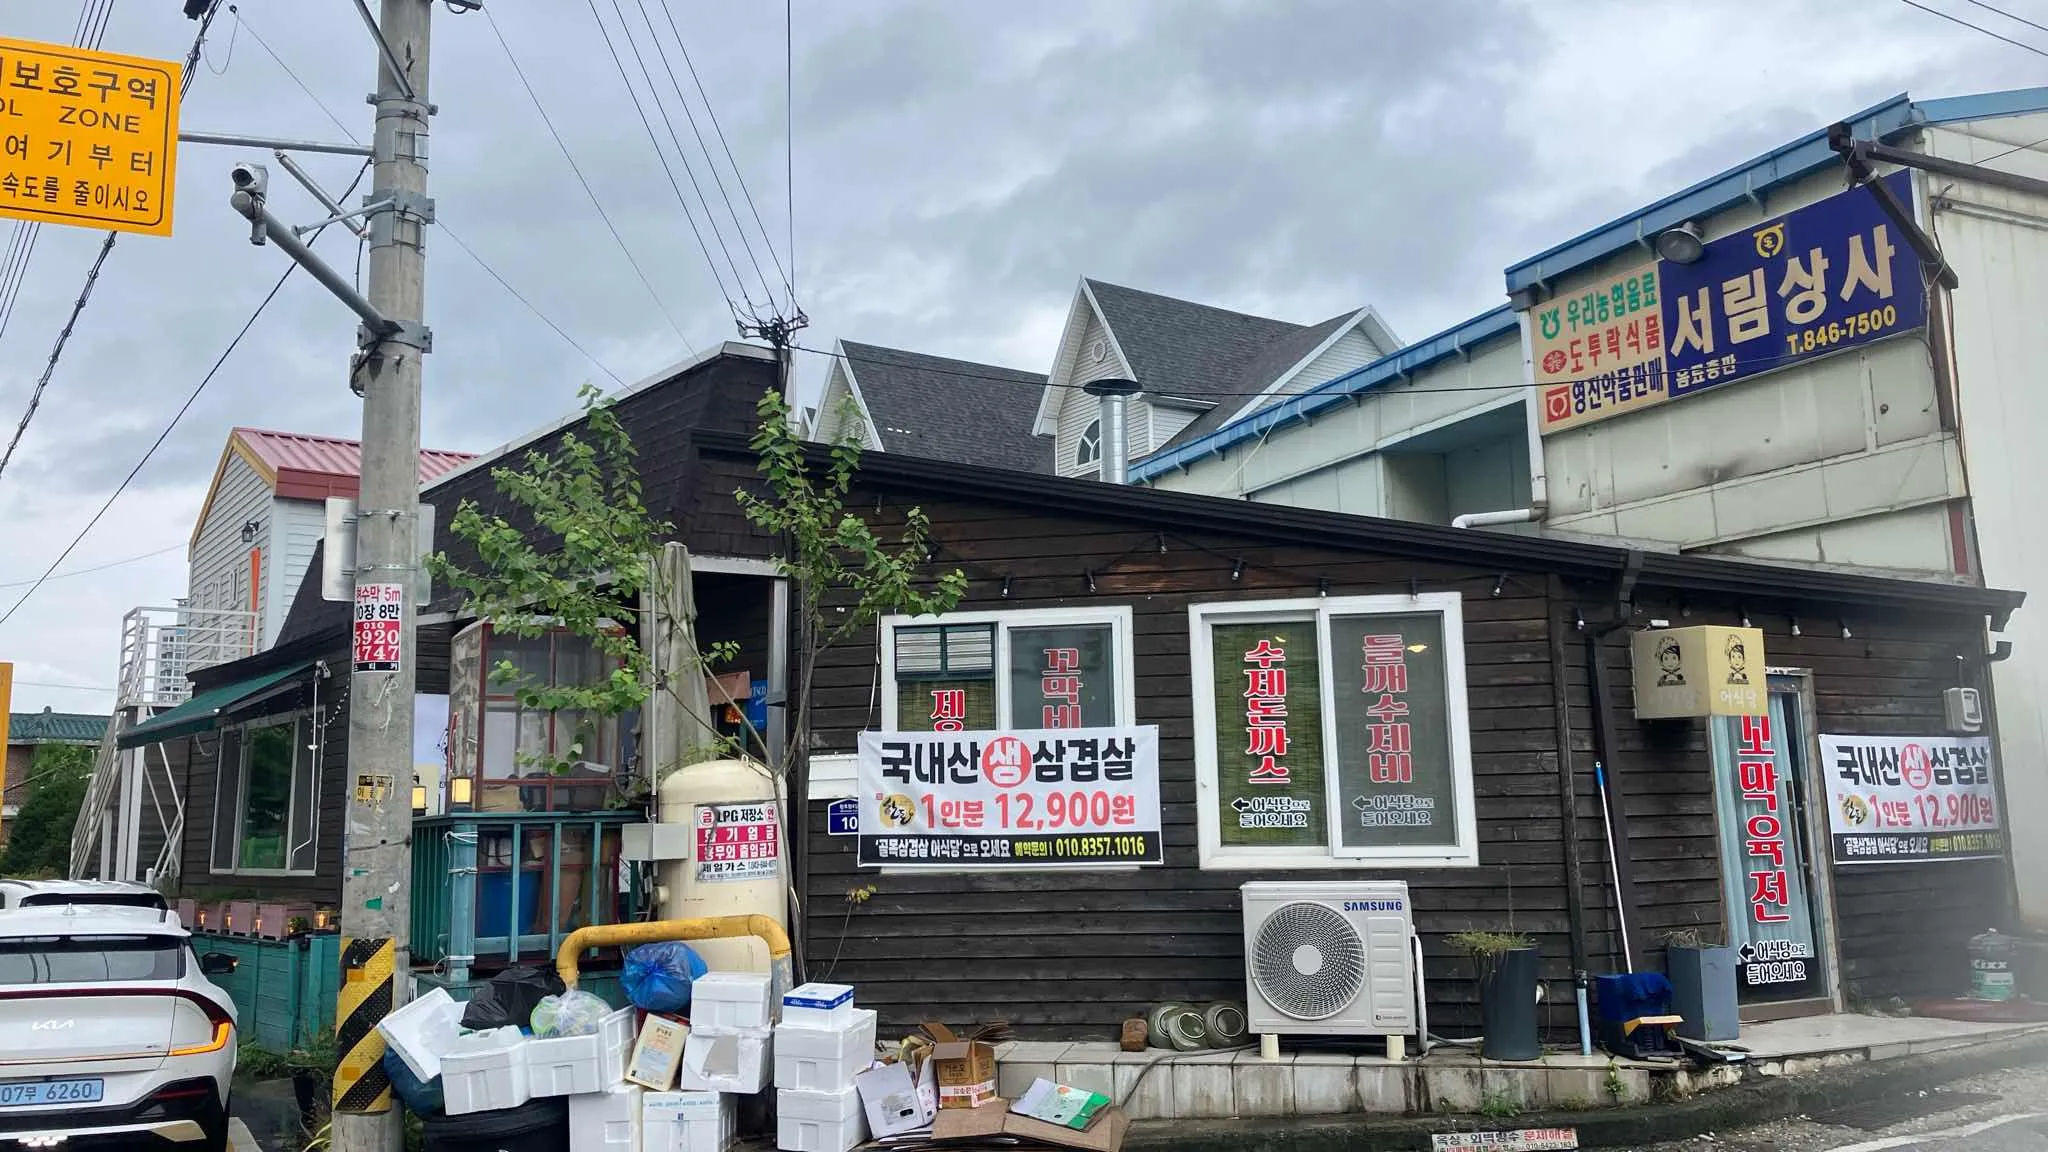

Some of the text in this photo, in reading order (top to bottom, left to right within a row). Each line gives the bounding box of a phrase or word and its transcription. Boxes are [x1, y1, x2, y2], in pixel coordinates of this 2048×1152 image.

[0, 56, 157, 110] 보호구역
[58, 105, 141, 133] ZONE
[2, 171, 149, 212] 속도를 줄이시오
[1567, 271, 1657, 333] 우리농협음료
[1670, 223, 1896, 358] 서림상사
[1569, 313, 1660, 374] 도투락식품
[1785, 304, 1897, 355] T.846-7500
[379, 603, 400, 620] 8만
[1244, 639, 1291, 785] 수제돈까스
[1361, 634, 1413, 784] 들깨수제비
[881, 737, 1136, 787] 국내산 생 삼겹살
[1836, 744, 1989, 789] 국내산 생 삼겹살
[716, 808, 739, 823] LPG
[921, 792, 985, 829] 1인분
[995, 790, 1136, 831] 12,900원
[1239, 812, 1308, 828] 들어오세요
[1361, 810, 1433, 827] 들어오세요
[1868, 793, 1912, 828] 1인분
[1914, 793, 1995, 828] 12,900원
[980, 839, 1011, 858] 오세요
[1055, 835, 1145, 857] 010.8357.1016
[1343, 901, 1403, 912] SAMSUNG
[1747, 961, 1807, 985] 들어오세요
[46, 1082, 93, 1100] 6260
